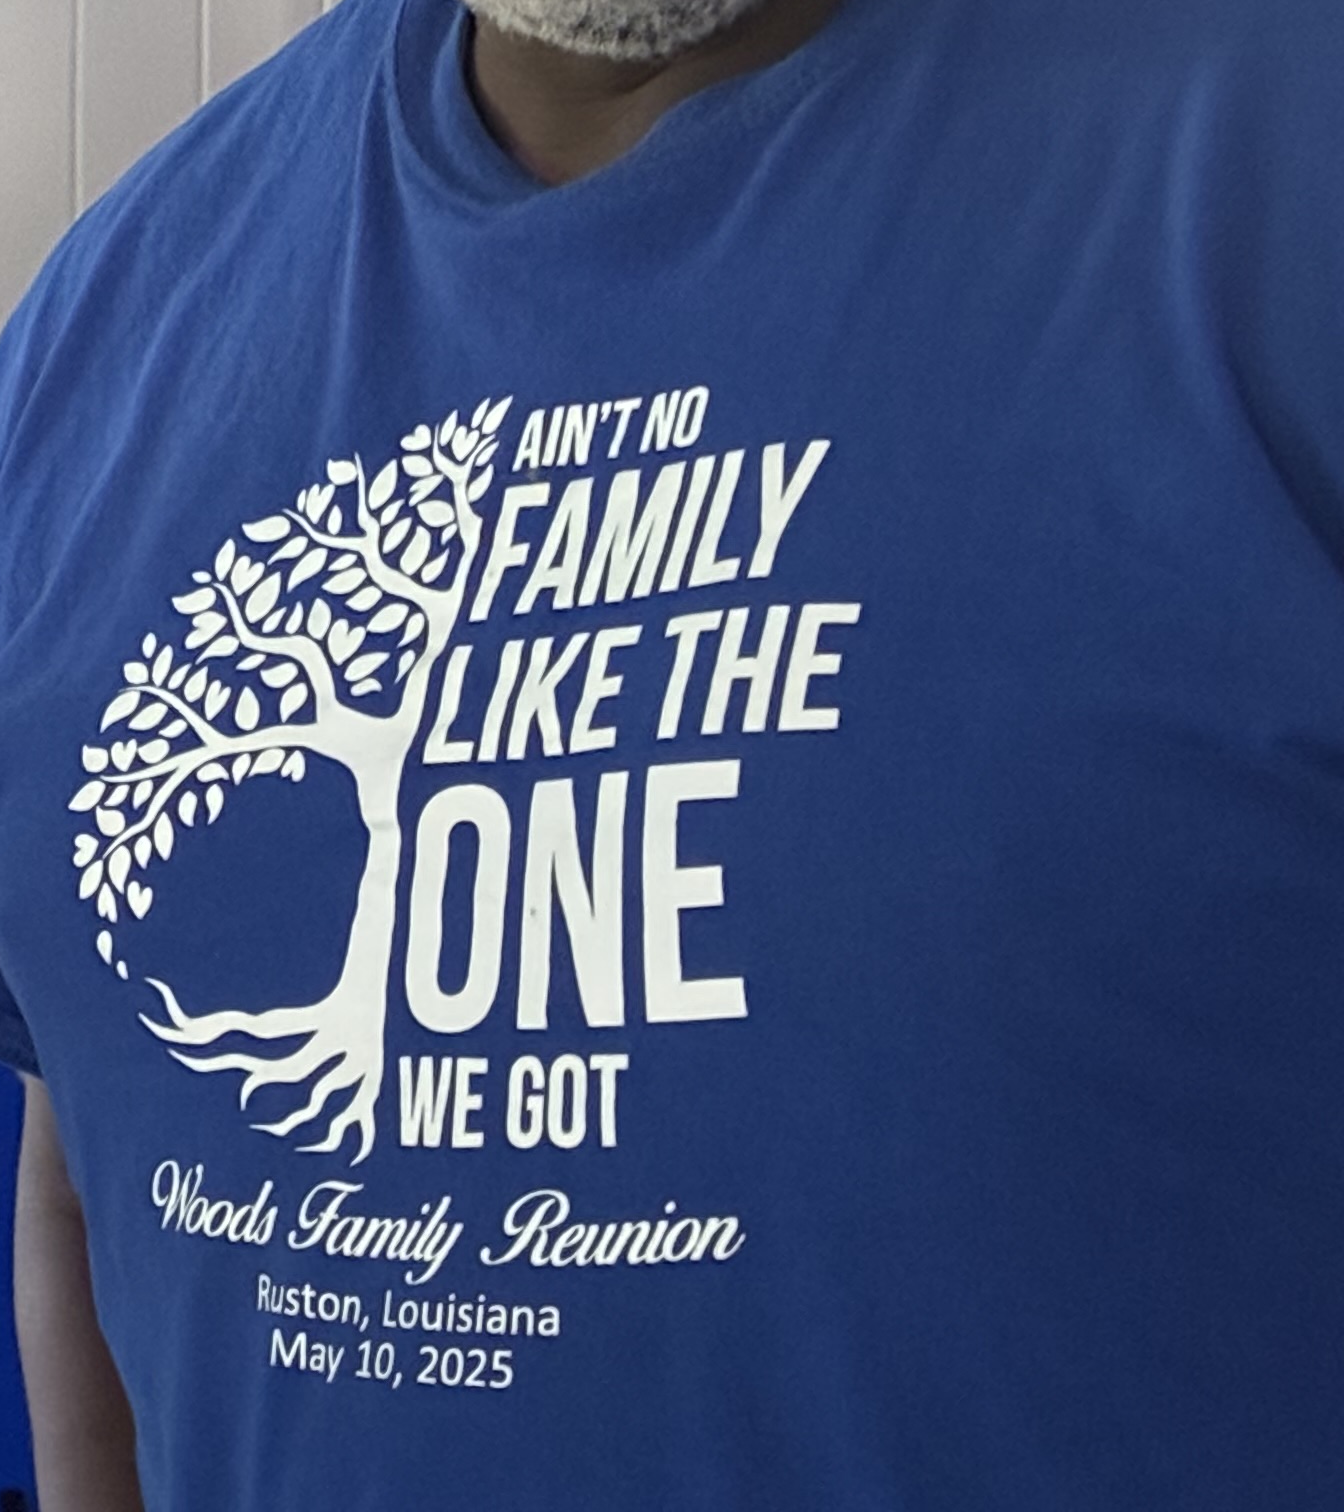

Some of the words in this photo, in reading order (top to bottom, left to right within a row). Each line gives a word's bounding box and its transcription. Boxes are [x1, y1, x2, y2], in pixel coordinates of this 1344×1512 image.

[513, 397, 641, 472] AIN'T
[640, 386, 709, 453] NO
[469, 440, 831, 622] FAMILY
[422, 624, 642, 764] LIKE
[656, 603, 861, 739] THE
[405, 759, 748, 1033] ONE
[399, 1055, 488, 1148] WE
[506, 1054, 629, 1149] GOT
[151, 1160, 278, 1245] Woods
[288, 1180, 463, 1285] Family
[480, 1189, 746, 1267] Reunion
[257, 1274, 370, 1332] Ruston,
[382, 1289, 561, 1337] Louisiana
[269, 1329, 344, 1382] May
[355, 1340, 402, 1389] 10,
[417, 1346, 514, 1389] 2025
